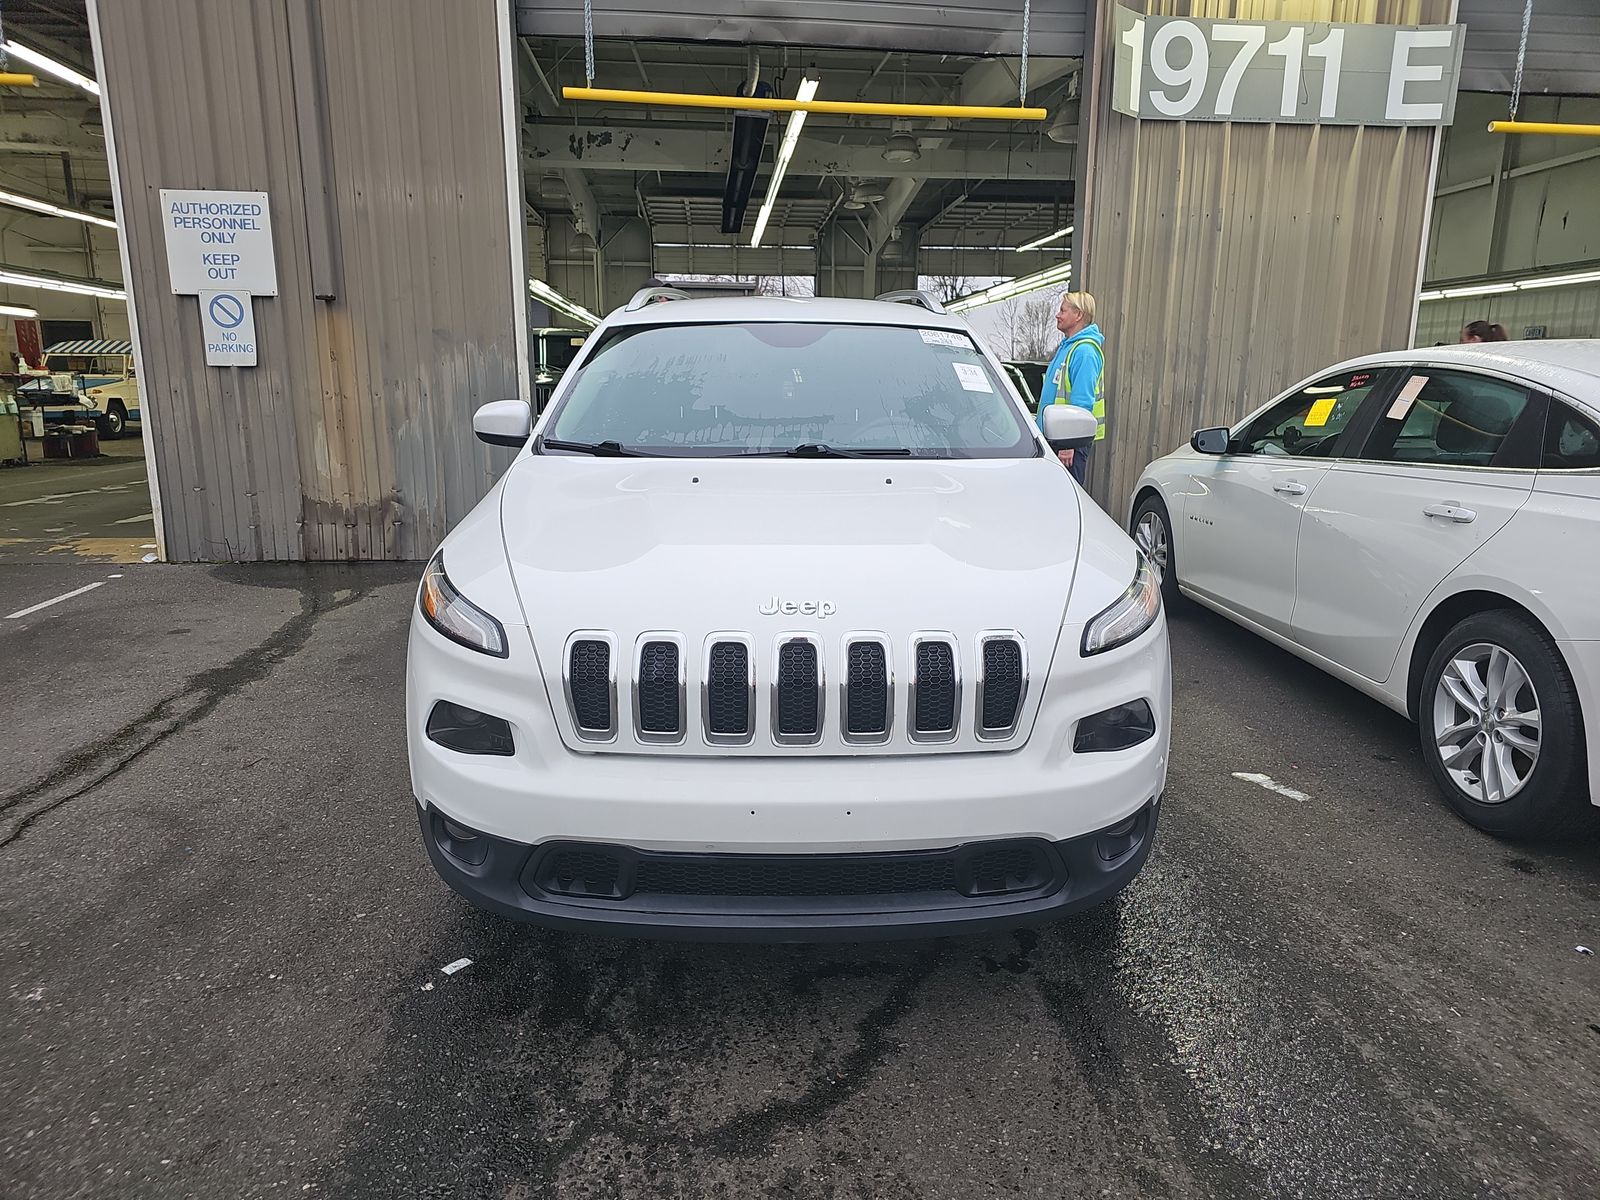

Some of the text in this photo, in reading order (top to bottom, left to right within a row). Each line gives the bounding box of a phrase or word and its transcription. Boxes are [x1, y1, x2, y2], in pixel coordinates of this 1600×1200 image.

[1122, 18, 1453, 120] 19711 E
[171, 202, 262, 216] AUTHORIZED
[174, 216, 261, 231] PERSONNEL
[200, 231, 237, 244] ONLY
[202, 253, 240, 266] KEEP
[207, 267, 237, 280] OUT
[222, 332, 237, 342] NO
[208, 343, 254, 353] PARKING
[758, 595, 837, 619] Jeep
